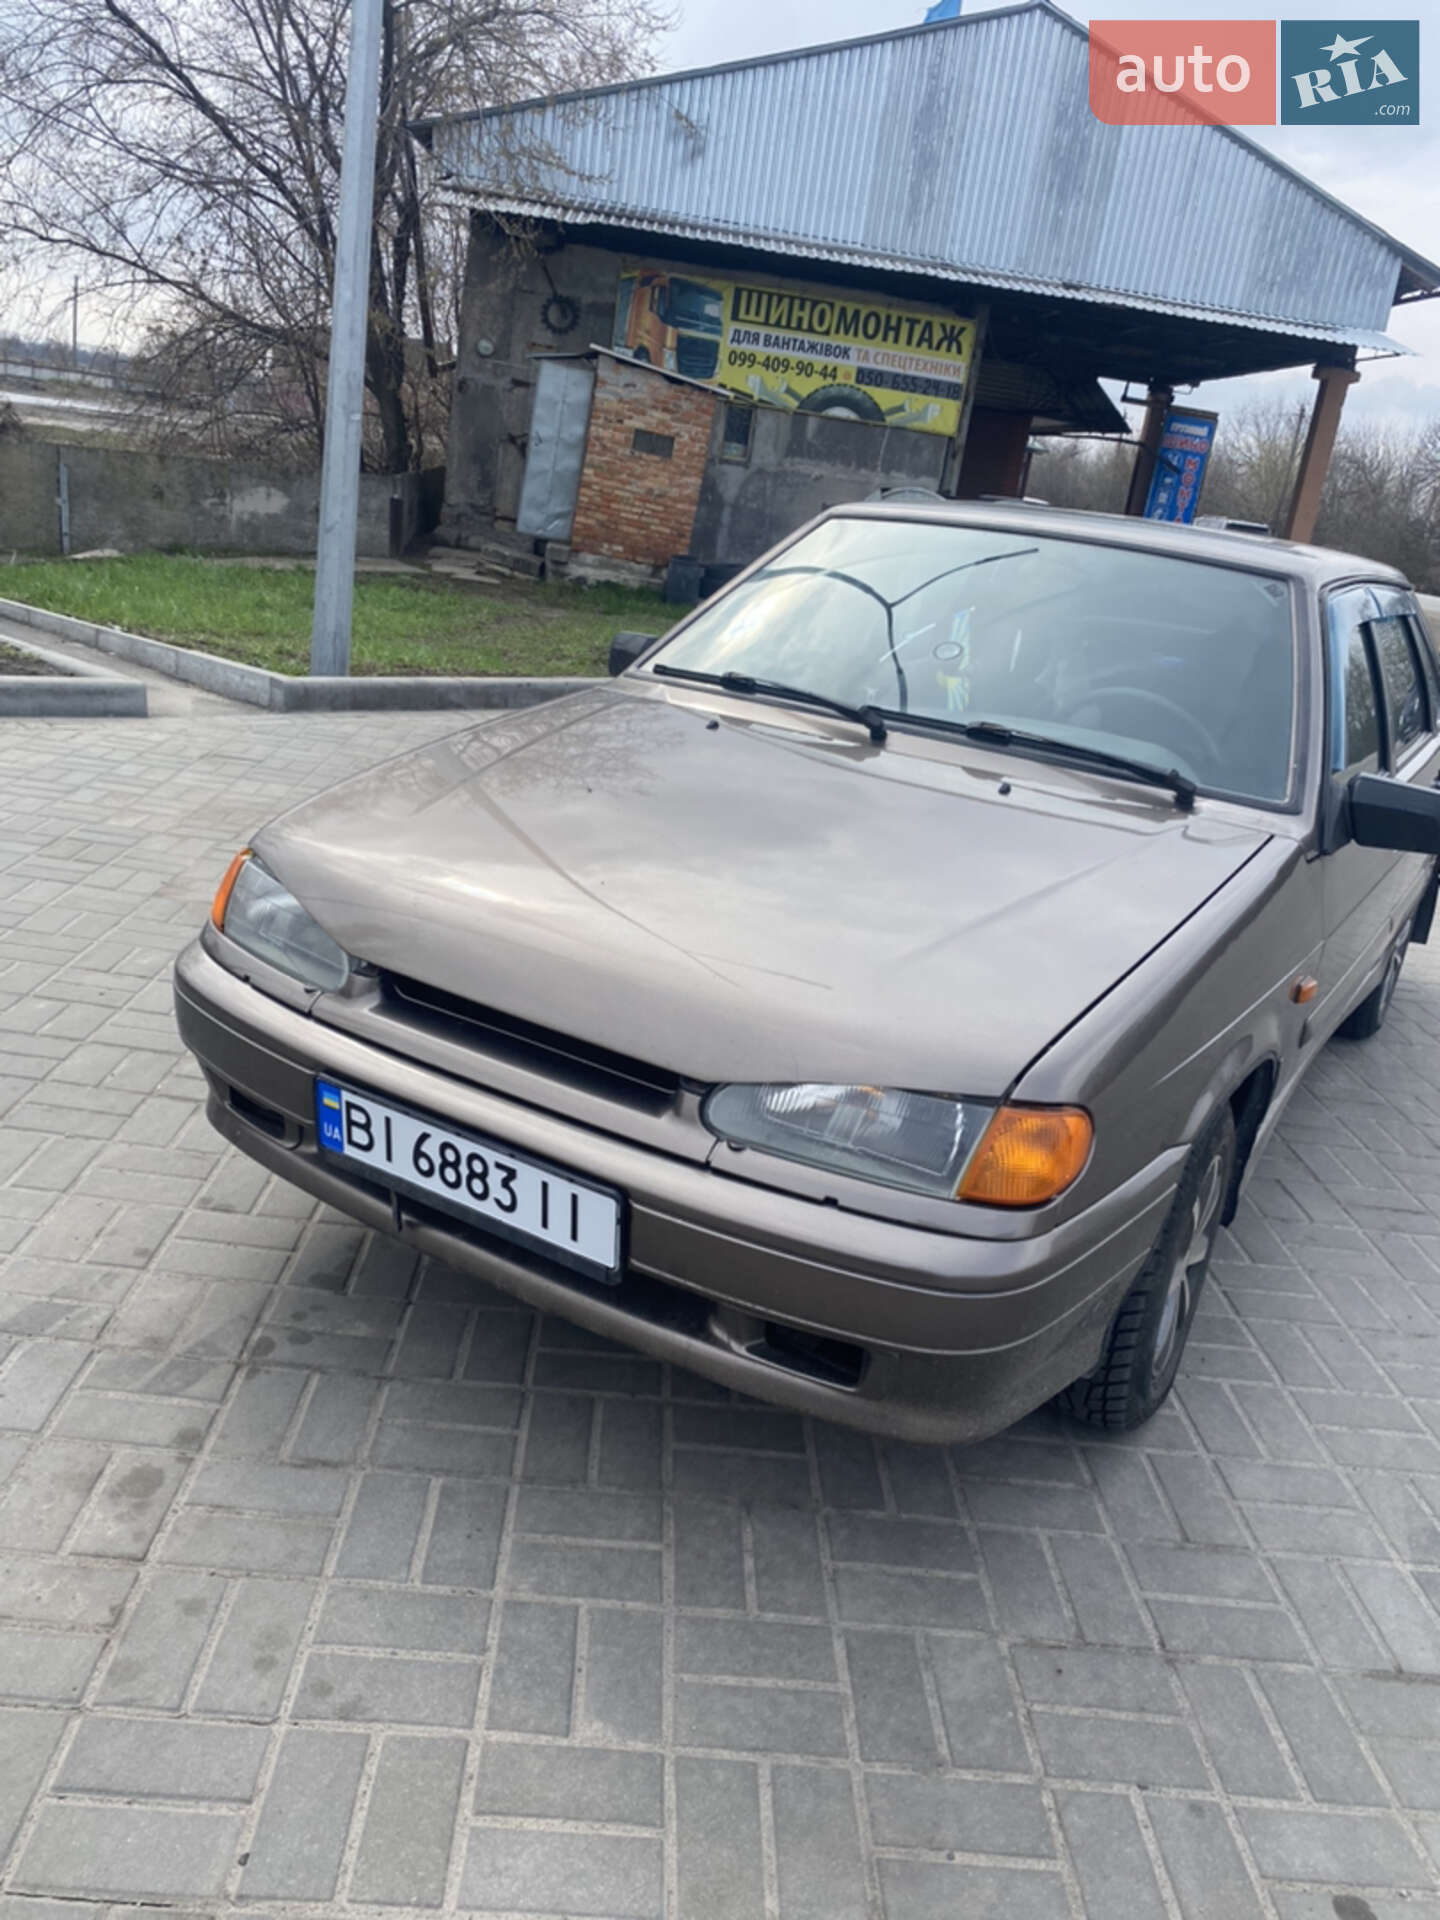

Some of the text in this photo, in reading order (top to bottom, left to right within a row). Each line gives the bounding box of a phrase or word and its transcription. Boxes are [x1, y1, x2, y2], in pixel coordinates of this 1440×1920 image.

[737, 289, 967, 355] ШИНОМОНТАЖ
[728, 350, 838, 381] 099-409-90-44
[730, 328, 962, 377] ДЛЯ ВАНТАЖІВОК ТА СПЕЦТЕХНІКИ
[323, 1122, 342, 1142] UA
[413, 1132, 519, 1214] 6883
